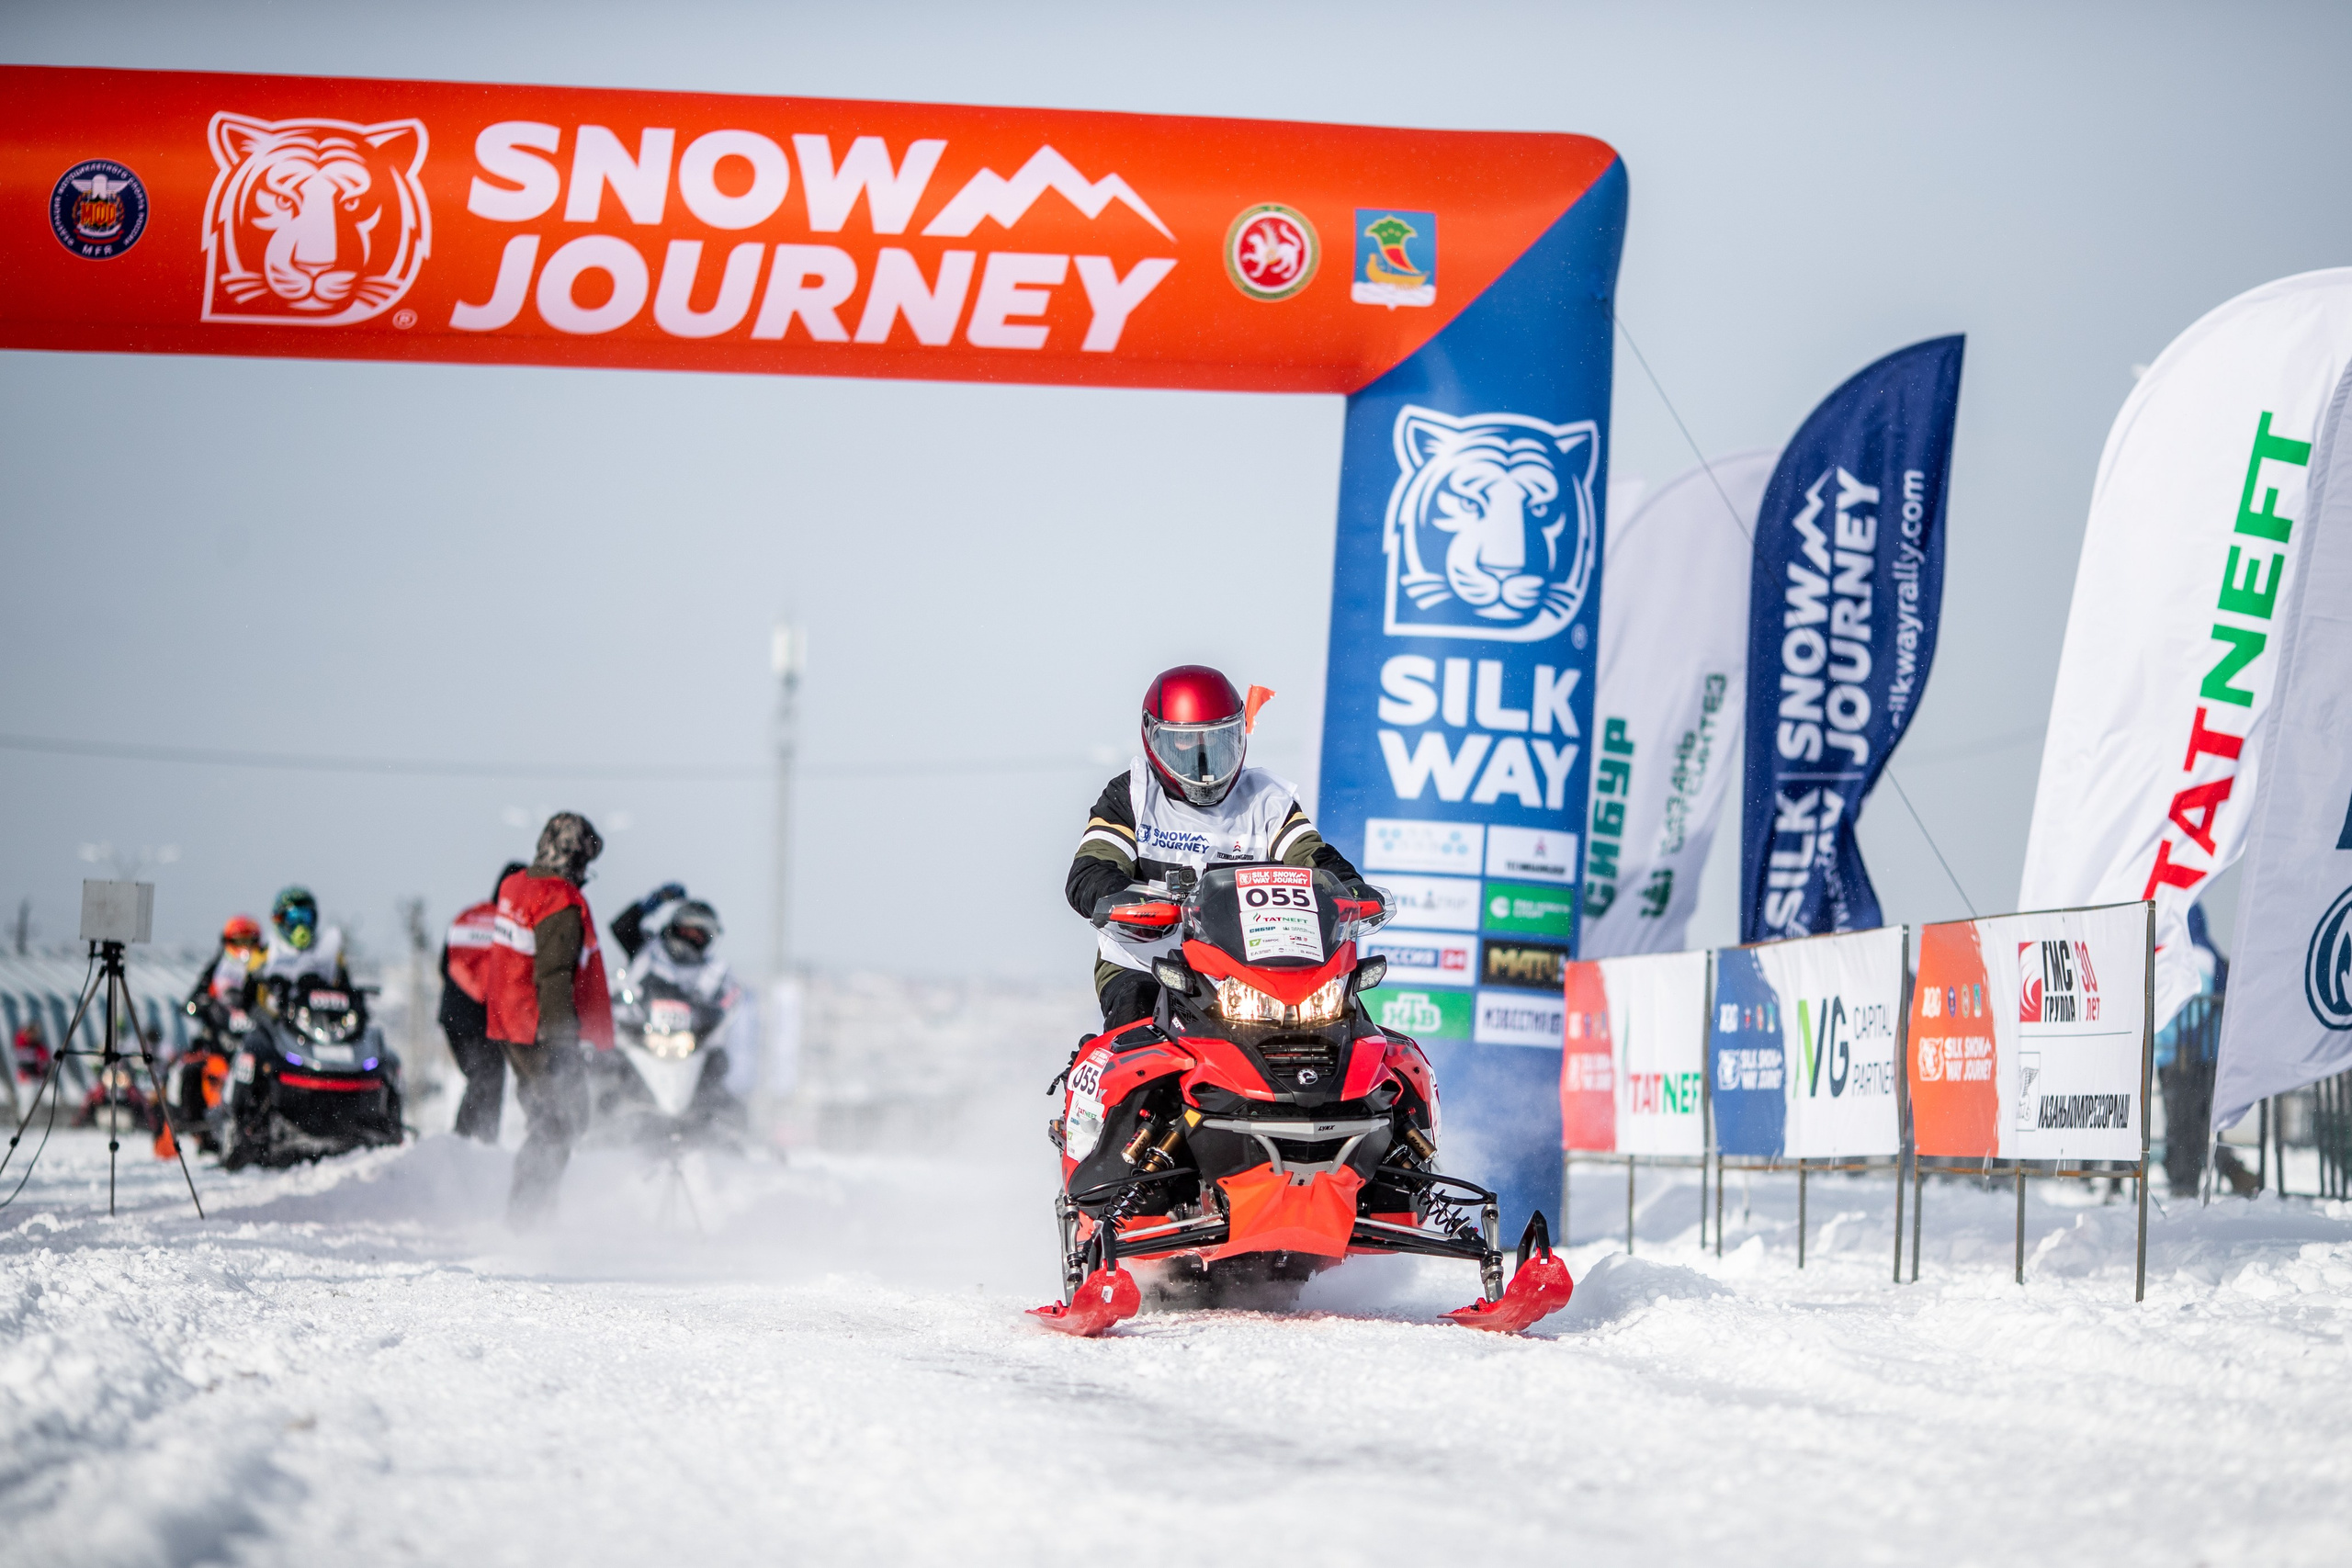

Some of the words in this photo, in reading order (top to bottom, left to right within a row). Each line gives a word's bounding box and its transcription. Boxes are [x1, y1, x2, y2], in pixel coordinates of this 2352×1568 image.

[467, 120, 948, 235] SNOW
[448, 234, 1179, 352] JOURNEY
[1825, 466, 1881, 766] JOURNEY
[1776, 562, 1831, 762] SNOW
[2142, 410, 2312, 901] TATNEFT
[1378, 654, 1582, 738] SILK
[1377, 729, 1579, 810] WAY
[1153, 828, 1192, 842] SNOW
[1583, 716, 1634, 919] СИБУР
[1151, 838, 1209, 854] JOURNEY
[1764, 786, 1821, 930] SILK
[1245, 888, 1310, 908] 055
[2041, 940, 2074, 992] ГМС
[2075, 941, 2098, 993] 30
[1382, 993, 1441, 1032] НТВ
[1853, 1004, 1892, 1040] CAPITAL
[2044, 995, 2075, 1022] ГРУППА
[1073, 1064, 1099, 1096] 055
[1630, 1073, 1702, 1114] TATNEF
[1078, 1106, 1098, 1120] TATNEFT
